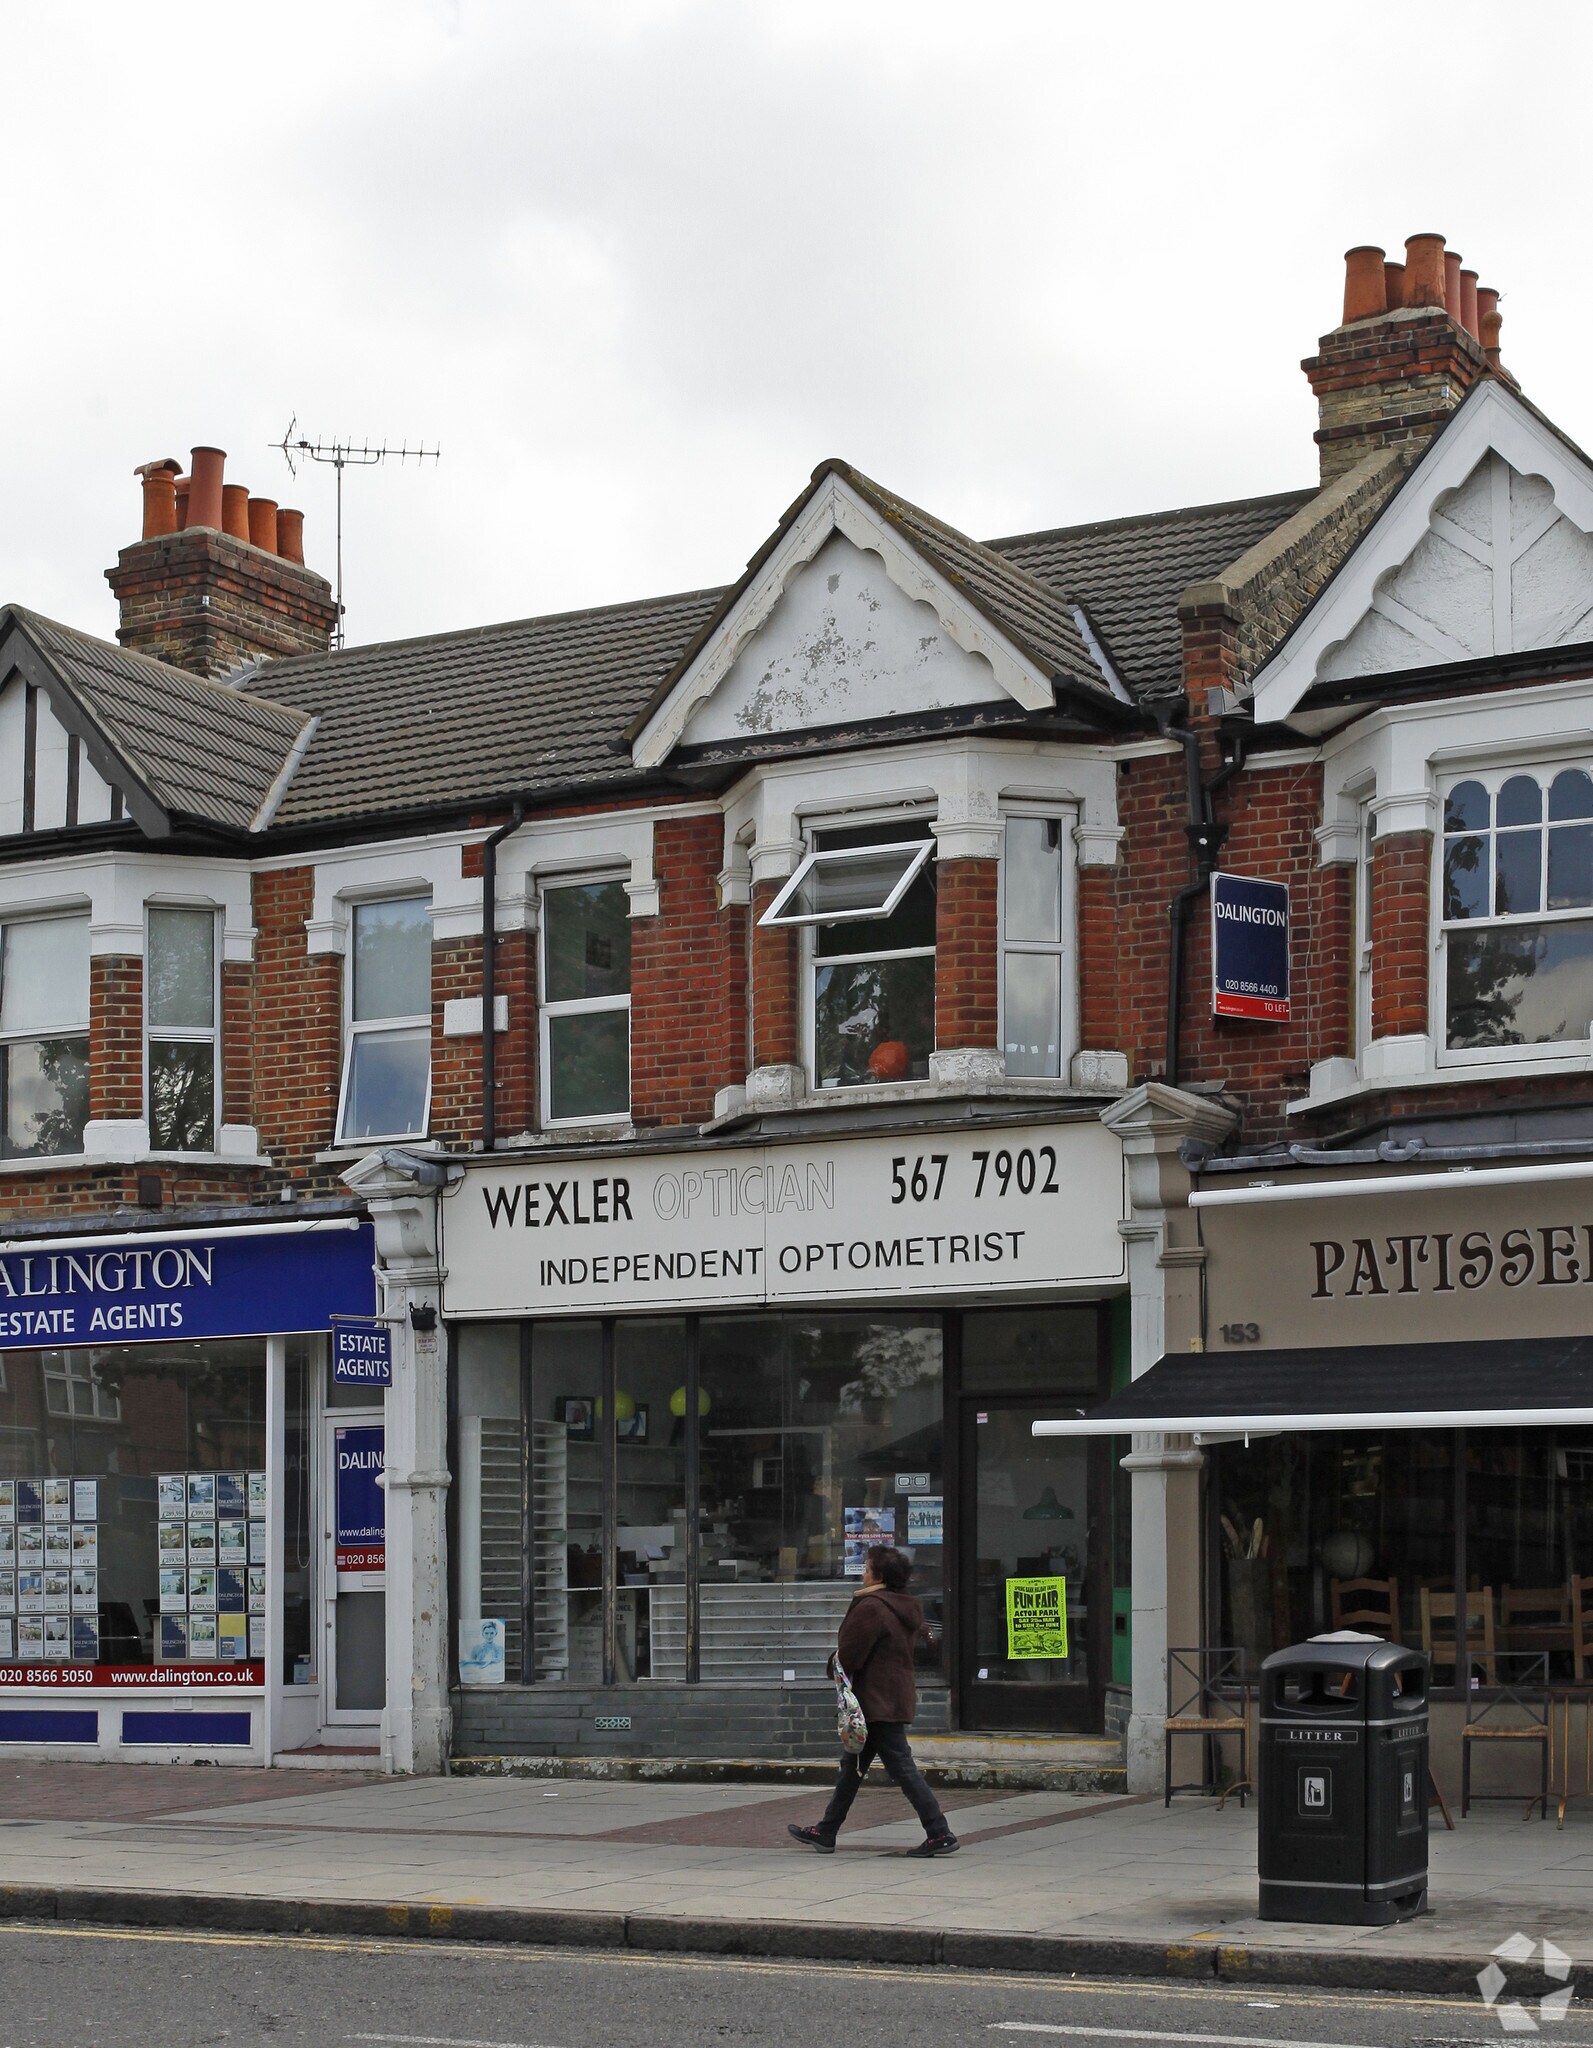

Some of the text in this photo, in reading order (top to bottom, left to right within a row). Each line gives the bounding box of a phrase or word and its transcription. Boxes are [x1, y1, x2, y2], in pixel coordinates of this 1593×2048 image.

[1216, 902, 1286, 927] DALINGTON
[1225, 979, 1278, 995] 020 8566 4400
[1264, 1002, 1286, 1013] TO LET
[482, 1146, 1060, 1229] WEXLER OPTICIAN 567 7902
[540, 1231, 1026, 1287] INDEPENDENT OPTOMETRIST
[0, 1302, 183, 1336] ESTATE AGENTS
[1219, 1323, 1261, 1344] 153
[339, 1333, 386, 1354] ESTATE
[337, 1358, 390, 1379] AGENTS
[346, 1554, 365, 1565] 020
[1014, 1590, 1058, 1608] FUN FAIR
[0, 1668, 254, 1686] 020 8566 5050 www.dalington.co.uk
[1290, 1731, 1343, 1742] LITTER
[1398, 1726, 1420, 1738] LITTER
